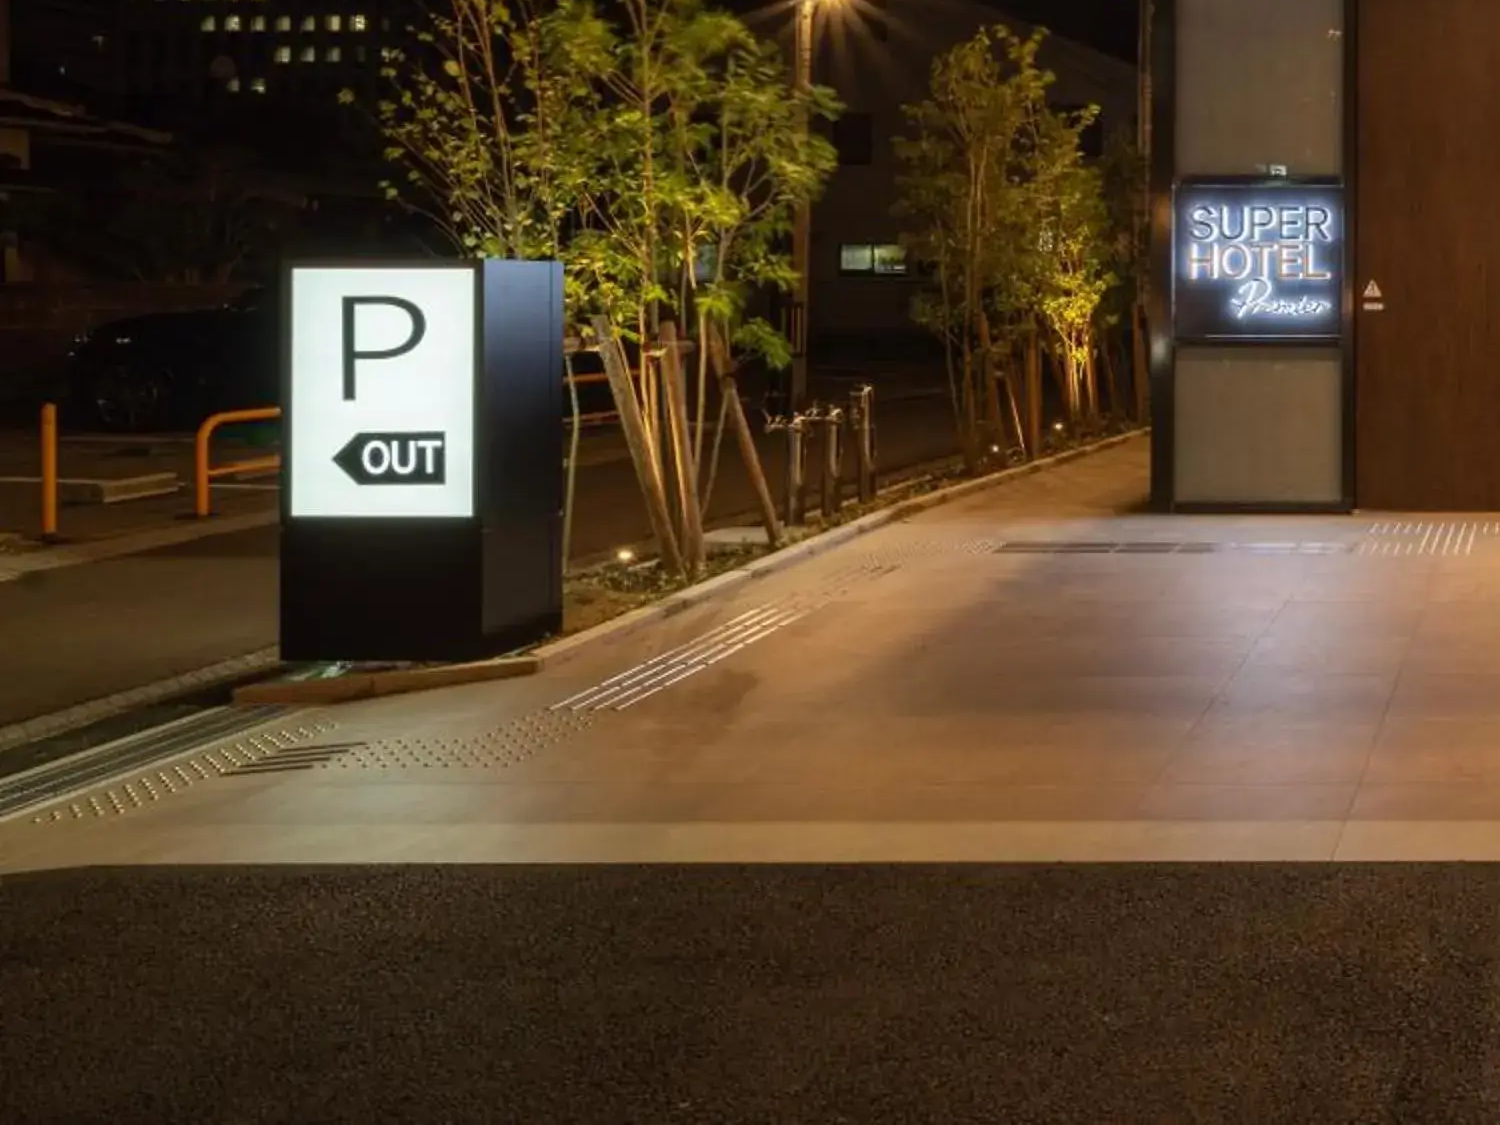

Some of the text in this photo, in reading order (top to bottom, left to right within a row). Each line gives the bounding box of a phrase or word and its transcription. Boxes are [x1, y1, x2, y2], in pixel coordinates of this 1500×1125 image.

[1189, 204, 1332, 243] SUPER
[1188, 242, 1332, 280] HOTEL
[341, 295, 426, 401] P
[361, 440, 443, 475] OUT
